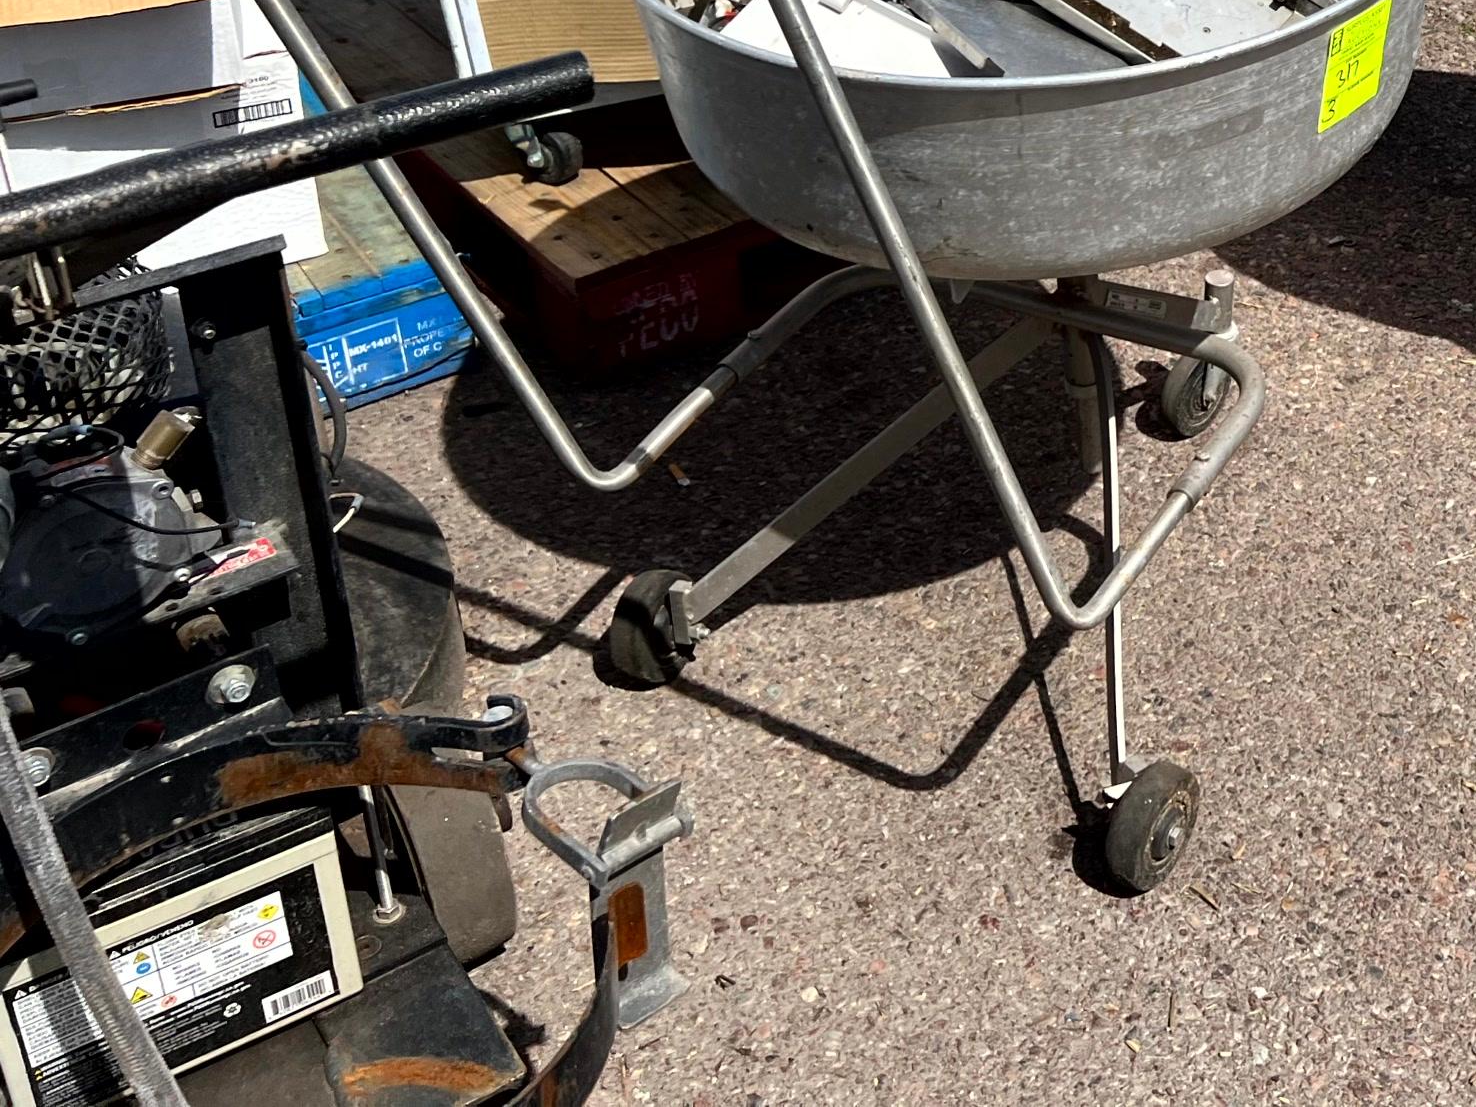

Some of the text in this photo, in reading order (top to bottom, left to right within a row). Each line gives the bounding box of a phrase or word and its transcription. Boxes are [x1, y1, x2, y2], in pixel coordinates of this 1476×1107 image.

[1336, 59, 1360, 89] 317
[1321, 98, 1336, 124] 3
[350, 333, 399, 357] MX-1401
[413, 344, 431, 359] OF
